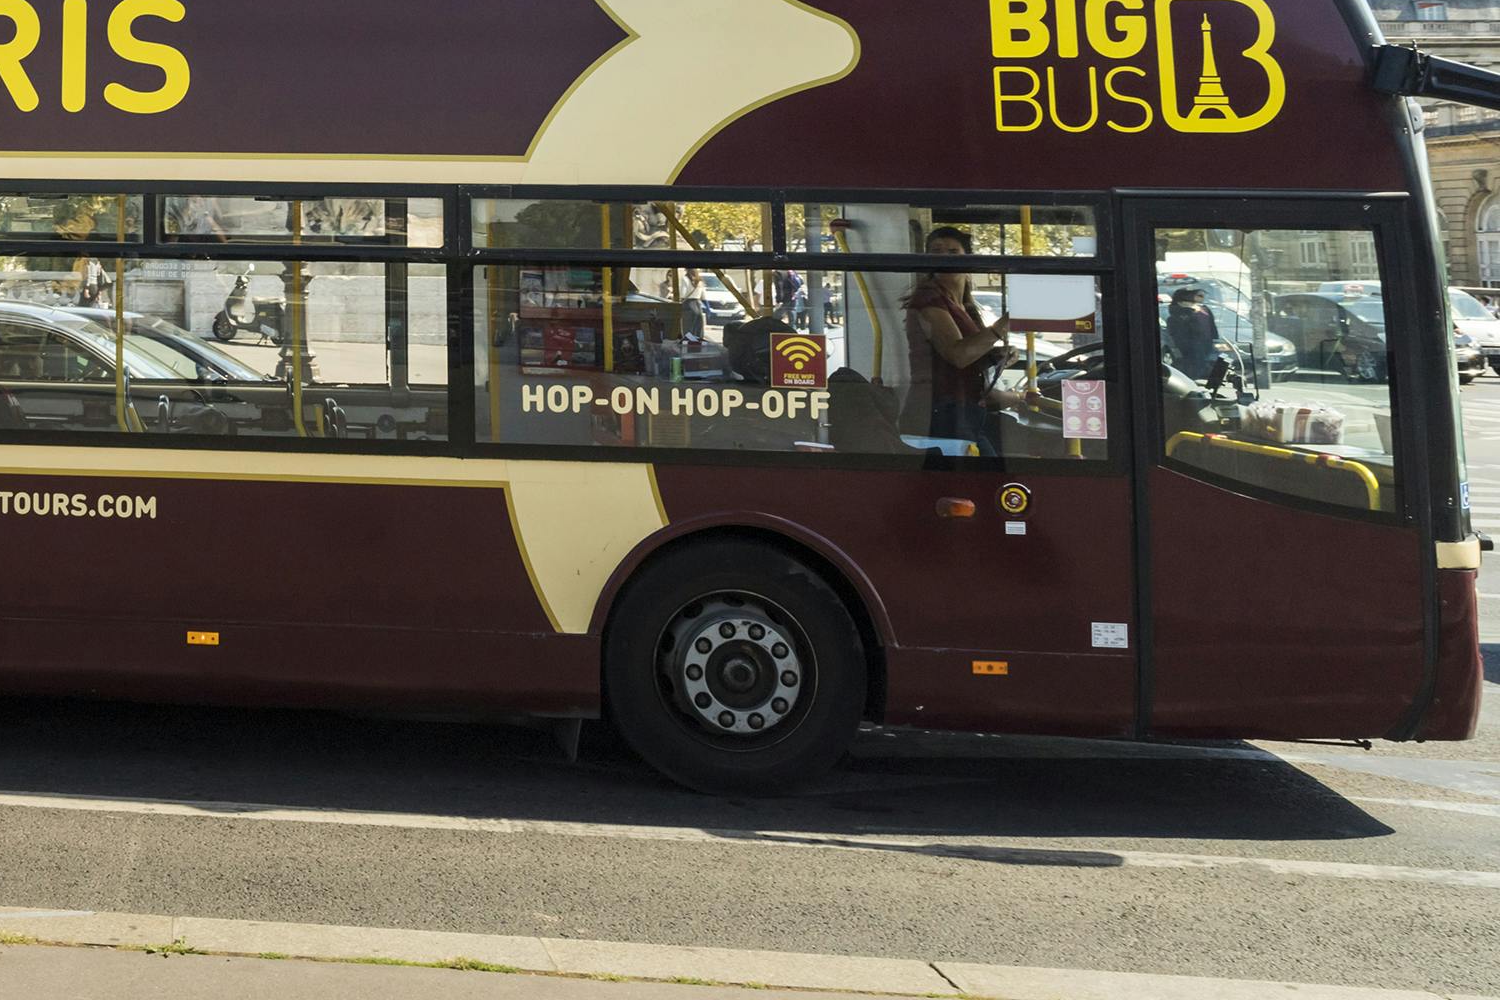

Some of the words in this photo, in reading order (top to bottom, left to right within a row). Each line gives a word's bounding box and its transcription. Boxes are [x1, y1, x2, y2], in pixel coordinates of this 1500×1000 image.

[993, 66, 1153, 133] BUS
[522, 384, 660, 415] HOP-ON
[671, 388, 831, 420] HOP-OFF
